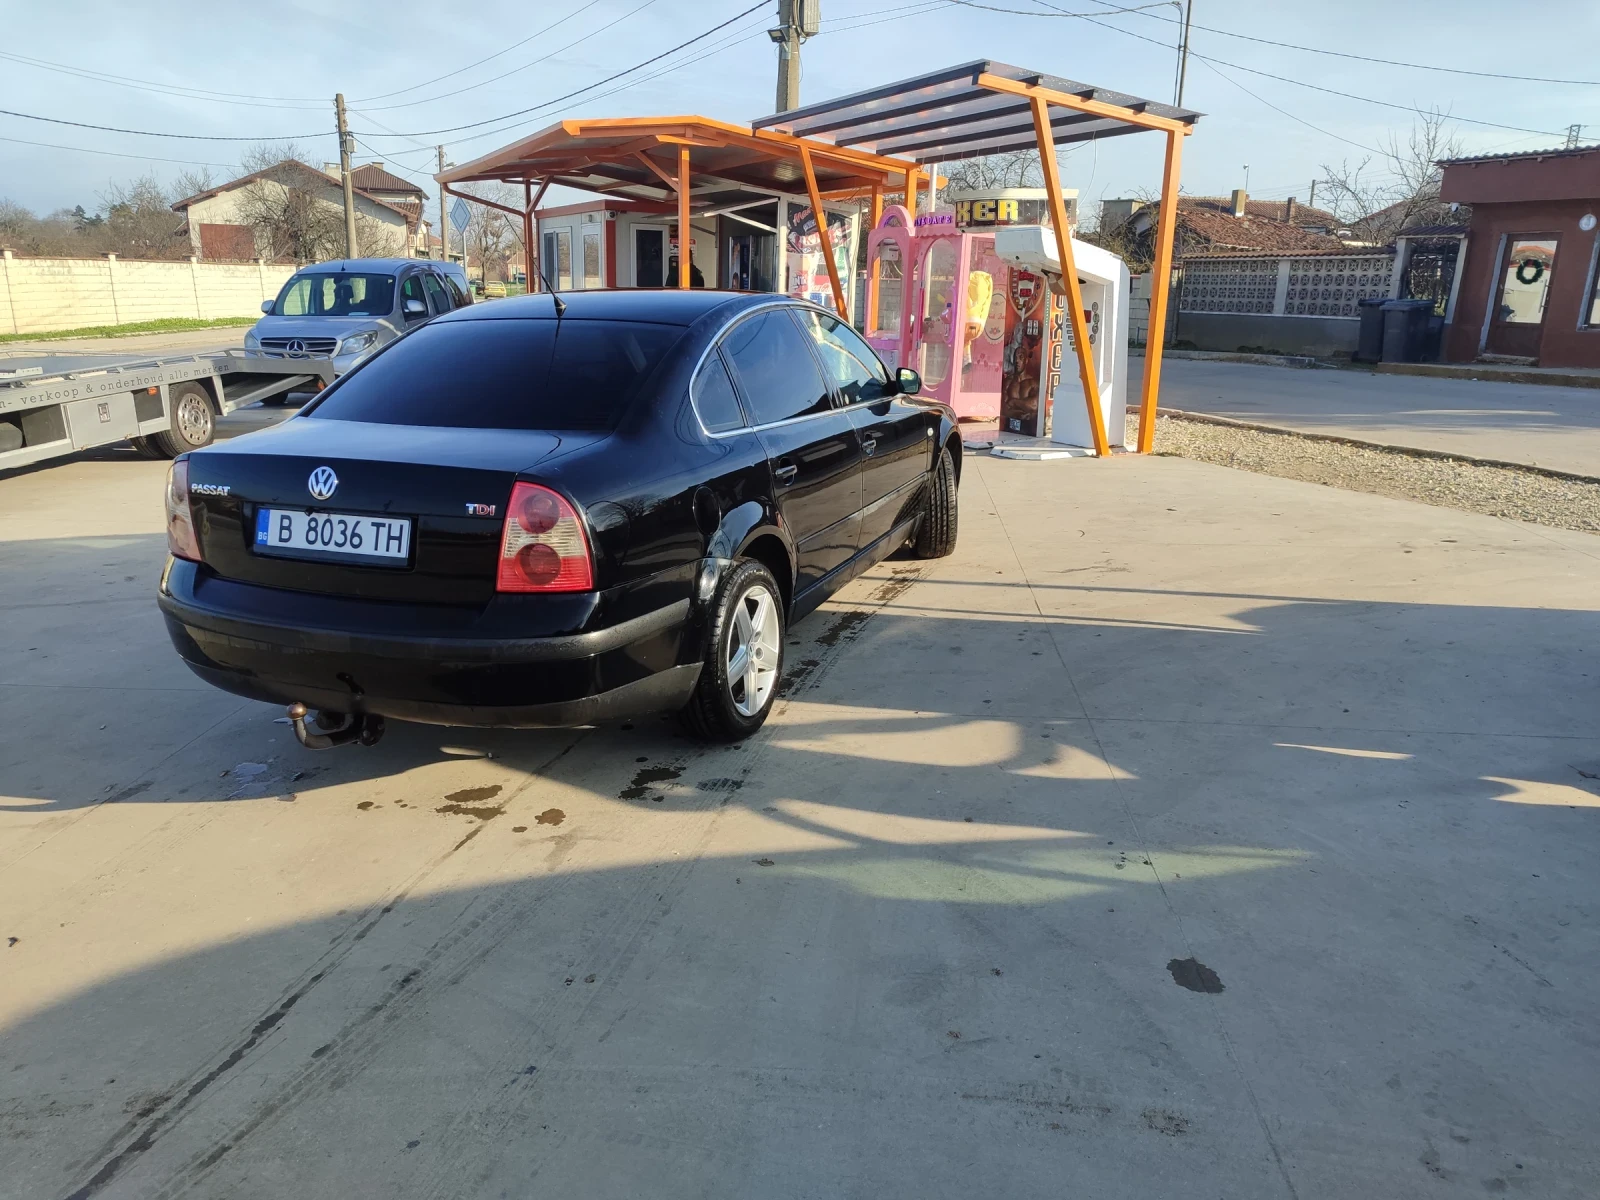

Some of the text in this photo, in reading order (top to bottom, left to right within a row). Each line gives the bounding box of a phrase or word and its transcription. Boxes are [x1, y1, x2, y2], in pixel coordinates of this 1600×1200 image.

[20, 388, 79, 405] verkoop
[85, 383, 94, 393] &
[100, 372, 165, 391] onderhoud
[169, 369, 189, 381] alle
[194, 364, 230, 377] merken
[191, 483, 231, 497] PASSAT
[465, 503, 496, 516] TDI
[258, 531, 268, 541] BG
[278, 514, 404, 553] B 8036 TH
